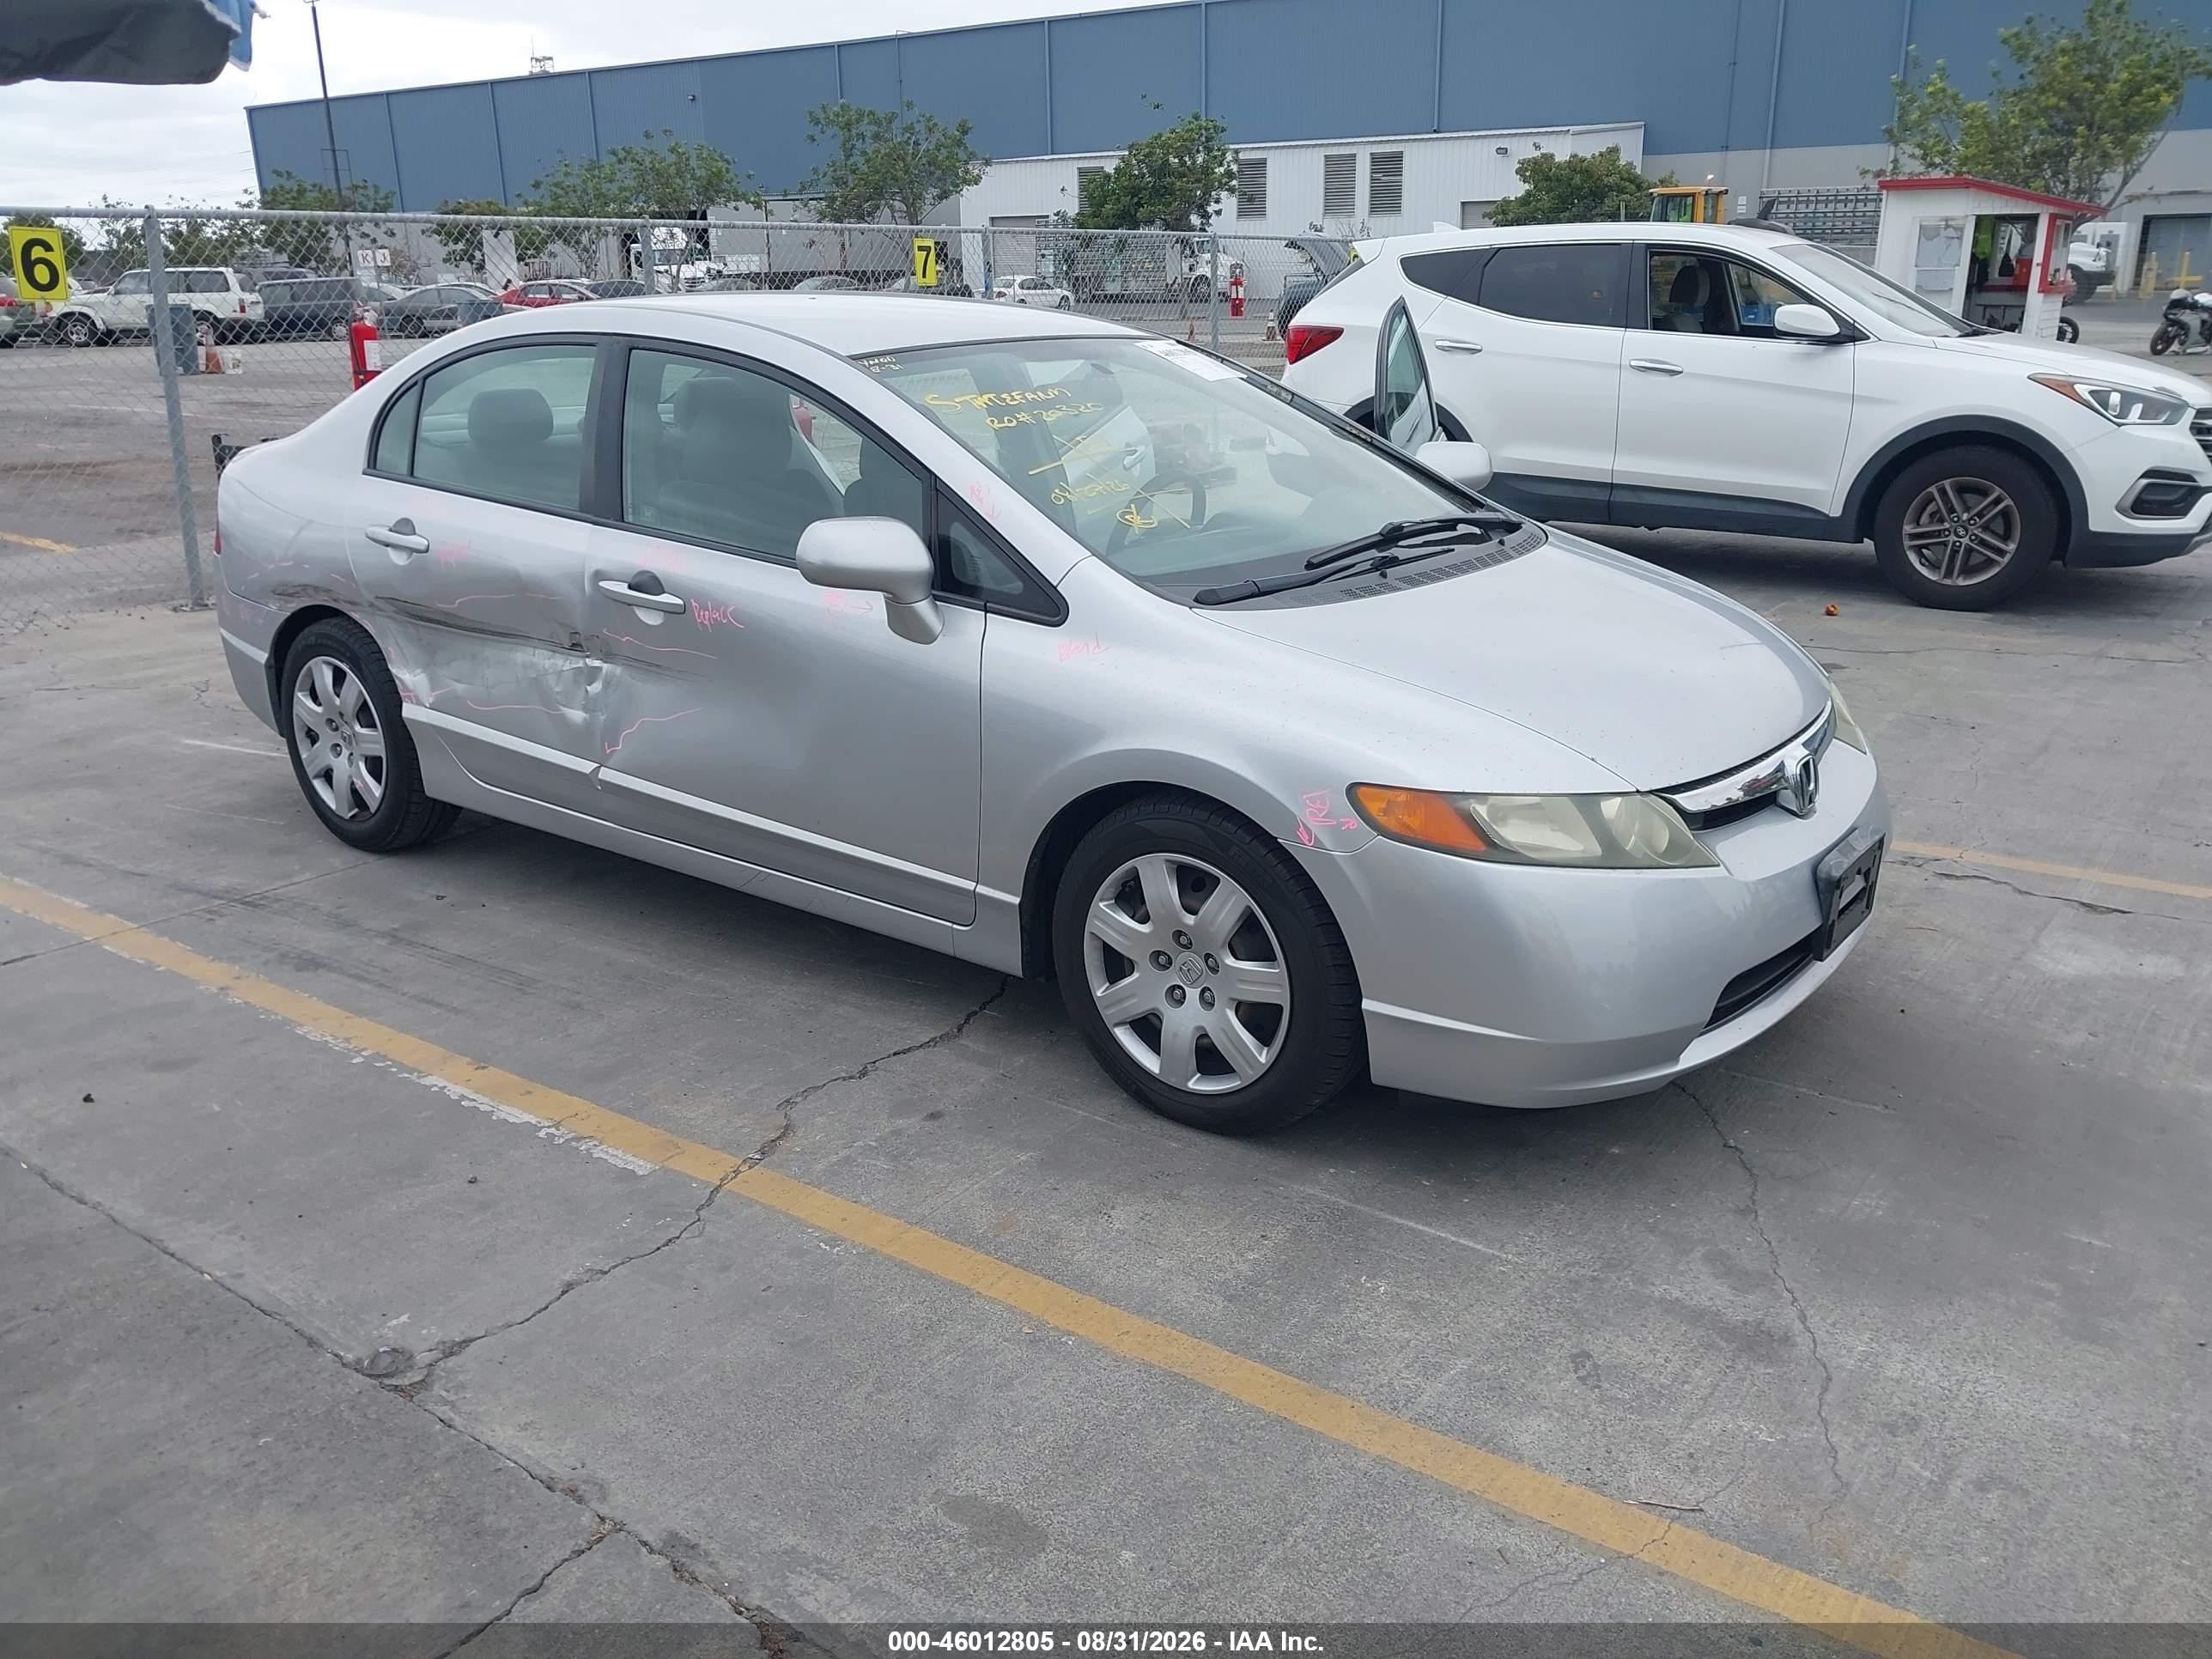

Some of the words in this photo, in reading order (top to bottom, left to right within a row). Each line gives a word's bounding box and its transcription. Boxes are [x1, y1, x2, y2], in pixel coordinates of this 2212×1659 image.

[21, 237, 60, 293] 6
[361, 253, 371, 264] K
[916, 245, 932, 279] 7
